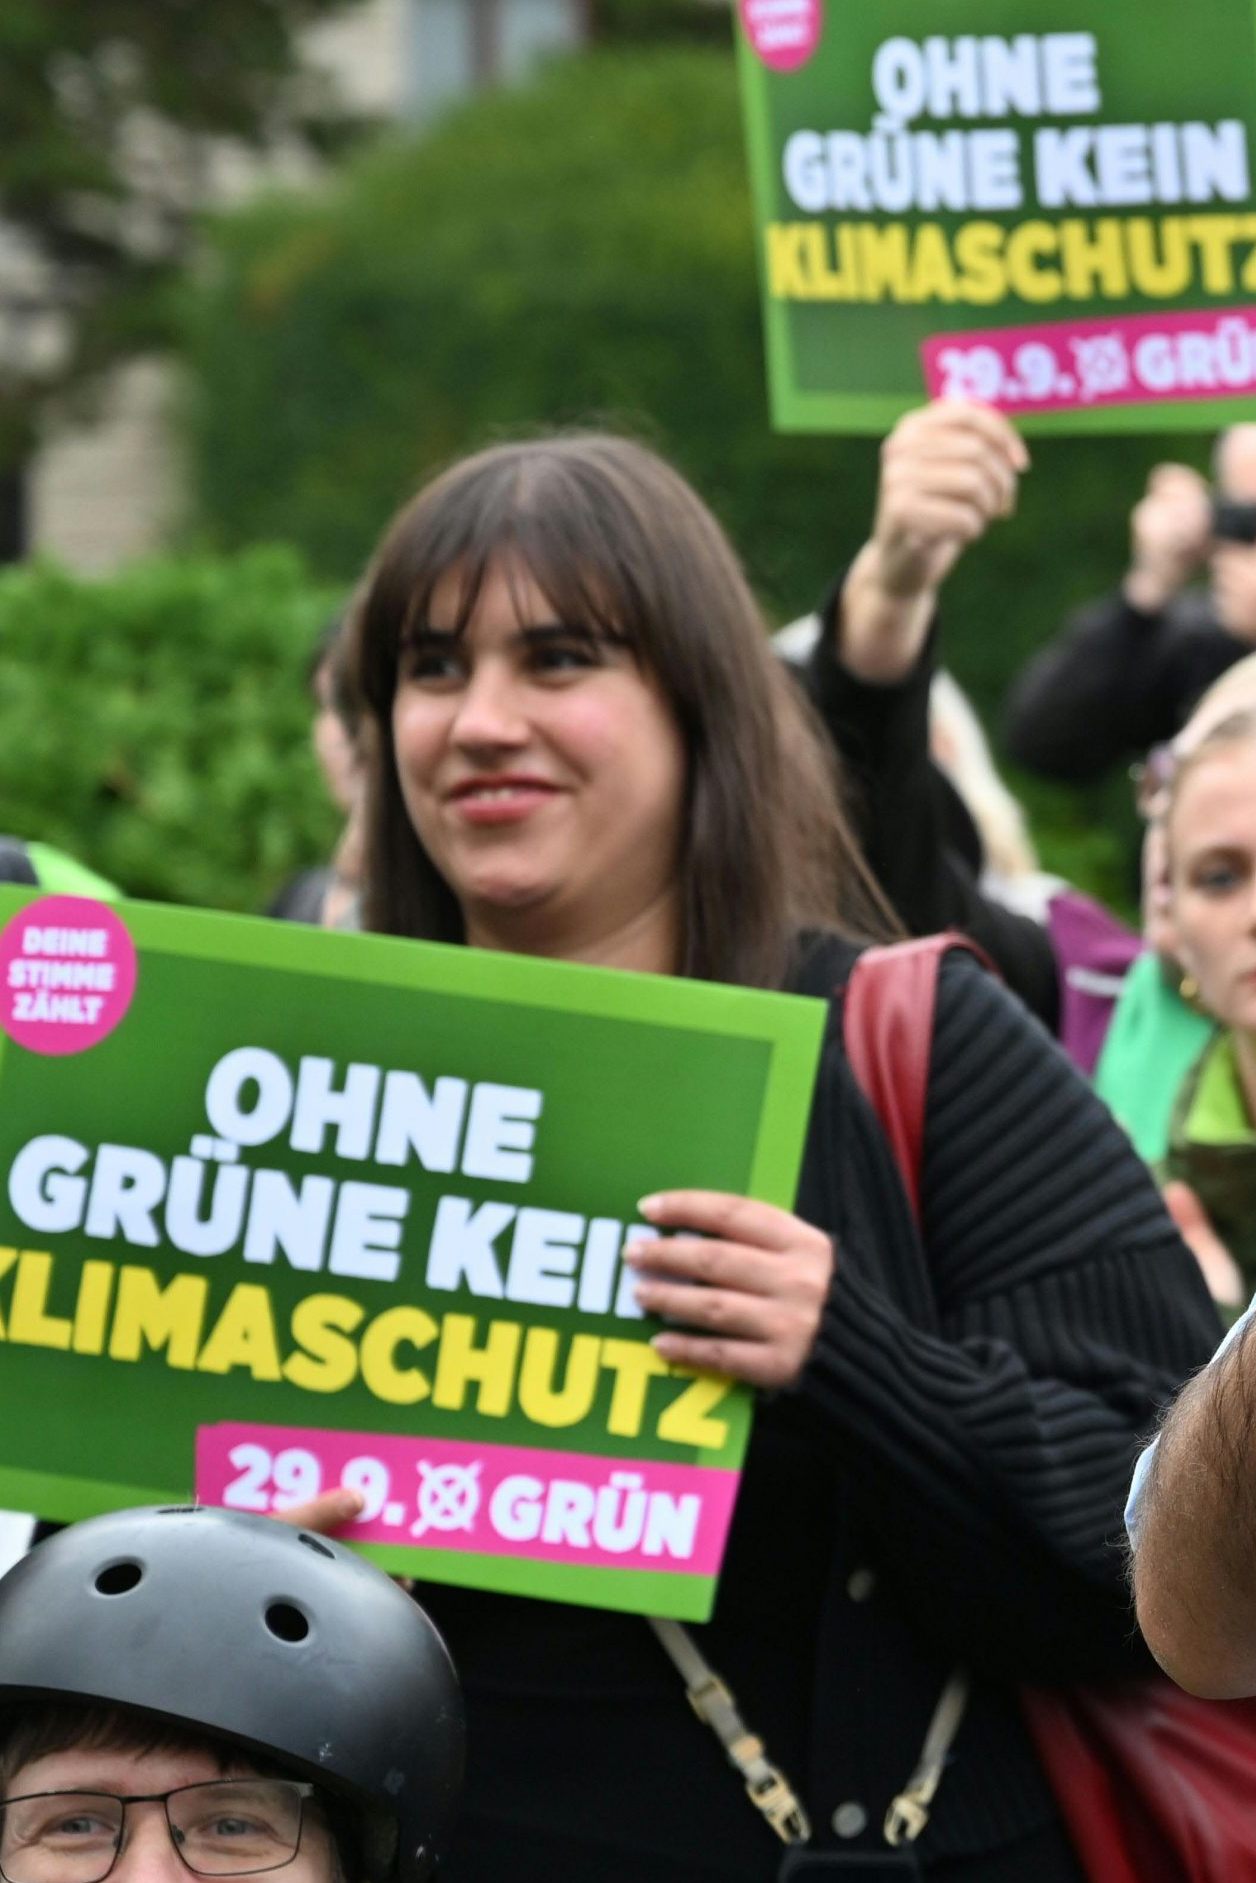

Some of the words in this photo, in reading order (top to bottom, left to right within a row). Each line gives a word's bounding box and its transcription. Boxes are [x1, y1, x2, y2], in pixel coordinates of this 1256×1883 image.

[872, 32, 1100, 119] OHNE
[782, 115, 1023, 213] GRÜNE
[1033, 119, 1250, 207] KEIN
[8, 957, 115, 991] STIMME
[22, 926, 108, 957] DEINE
[11, 988, 104, 1025] ZÄHLT
[204, 1046, 543, 1184] OHNE
[8, 1134, 411, 1283] GRÜNE
[0, 1245, 733, 1450] LIMASCHUTZ
[222, 1442, 406, 1526] 299.
[489, 1473, 703, 1560] GRÜN
